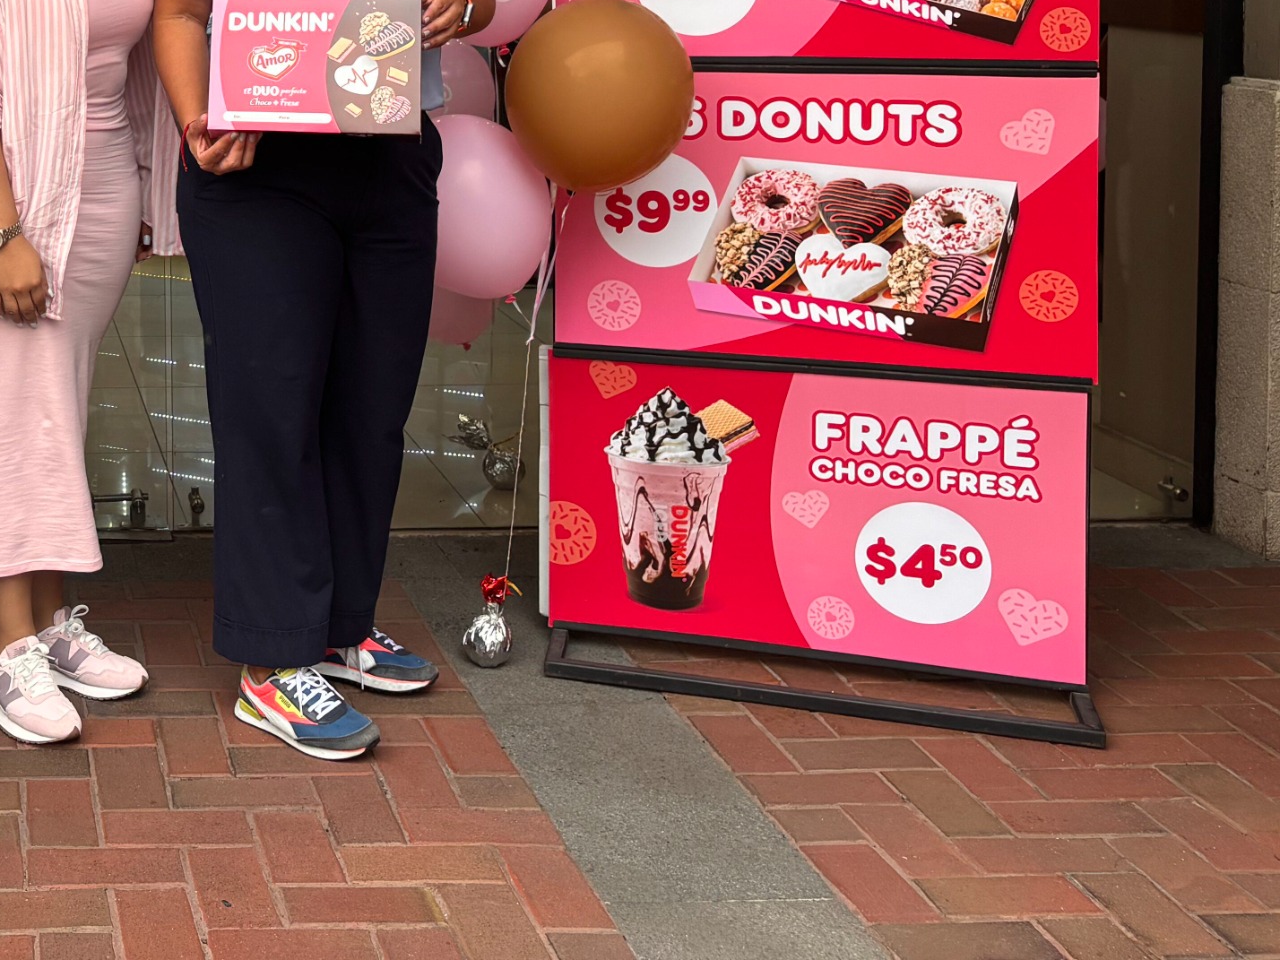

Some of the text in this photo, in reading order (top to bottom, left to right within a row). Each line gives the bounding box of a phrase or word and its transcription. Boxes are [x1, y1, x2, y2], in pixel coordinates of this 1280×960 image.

[228, 11, 335, 32] DUNKIN'
[249, 97, 273, 107] Choco
[252, 85, 279, 97] DUO
[720, 99, 961, 145] DONUTS
[752, 294, 916, 337] DUNKIN'
[814, 412, 1037, 469] FRAPPÉ
[811, 459, 1040, 501] CHOCO FRESA
